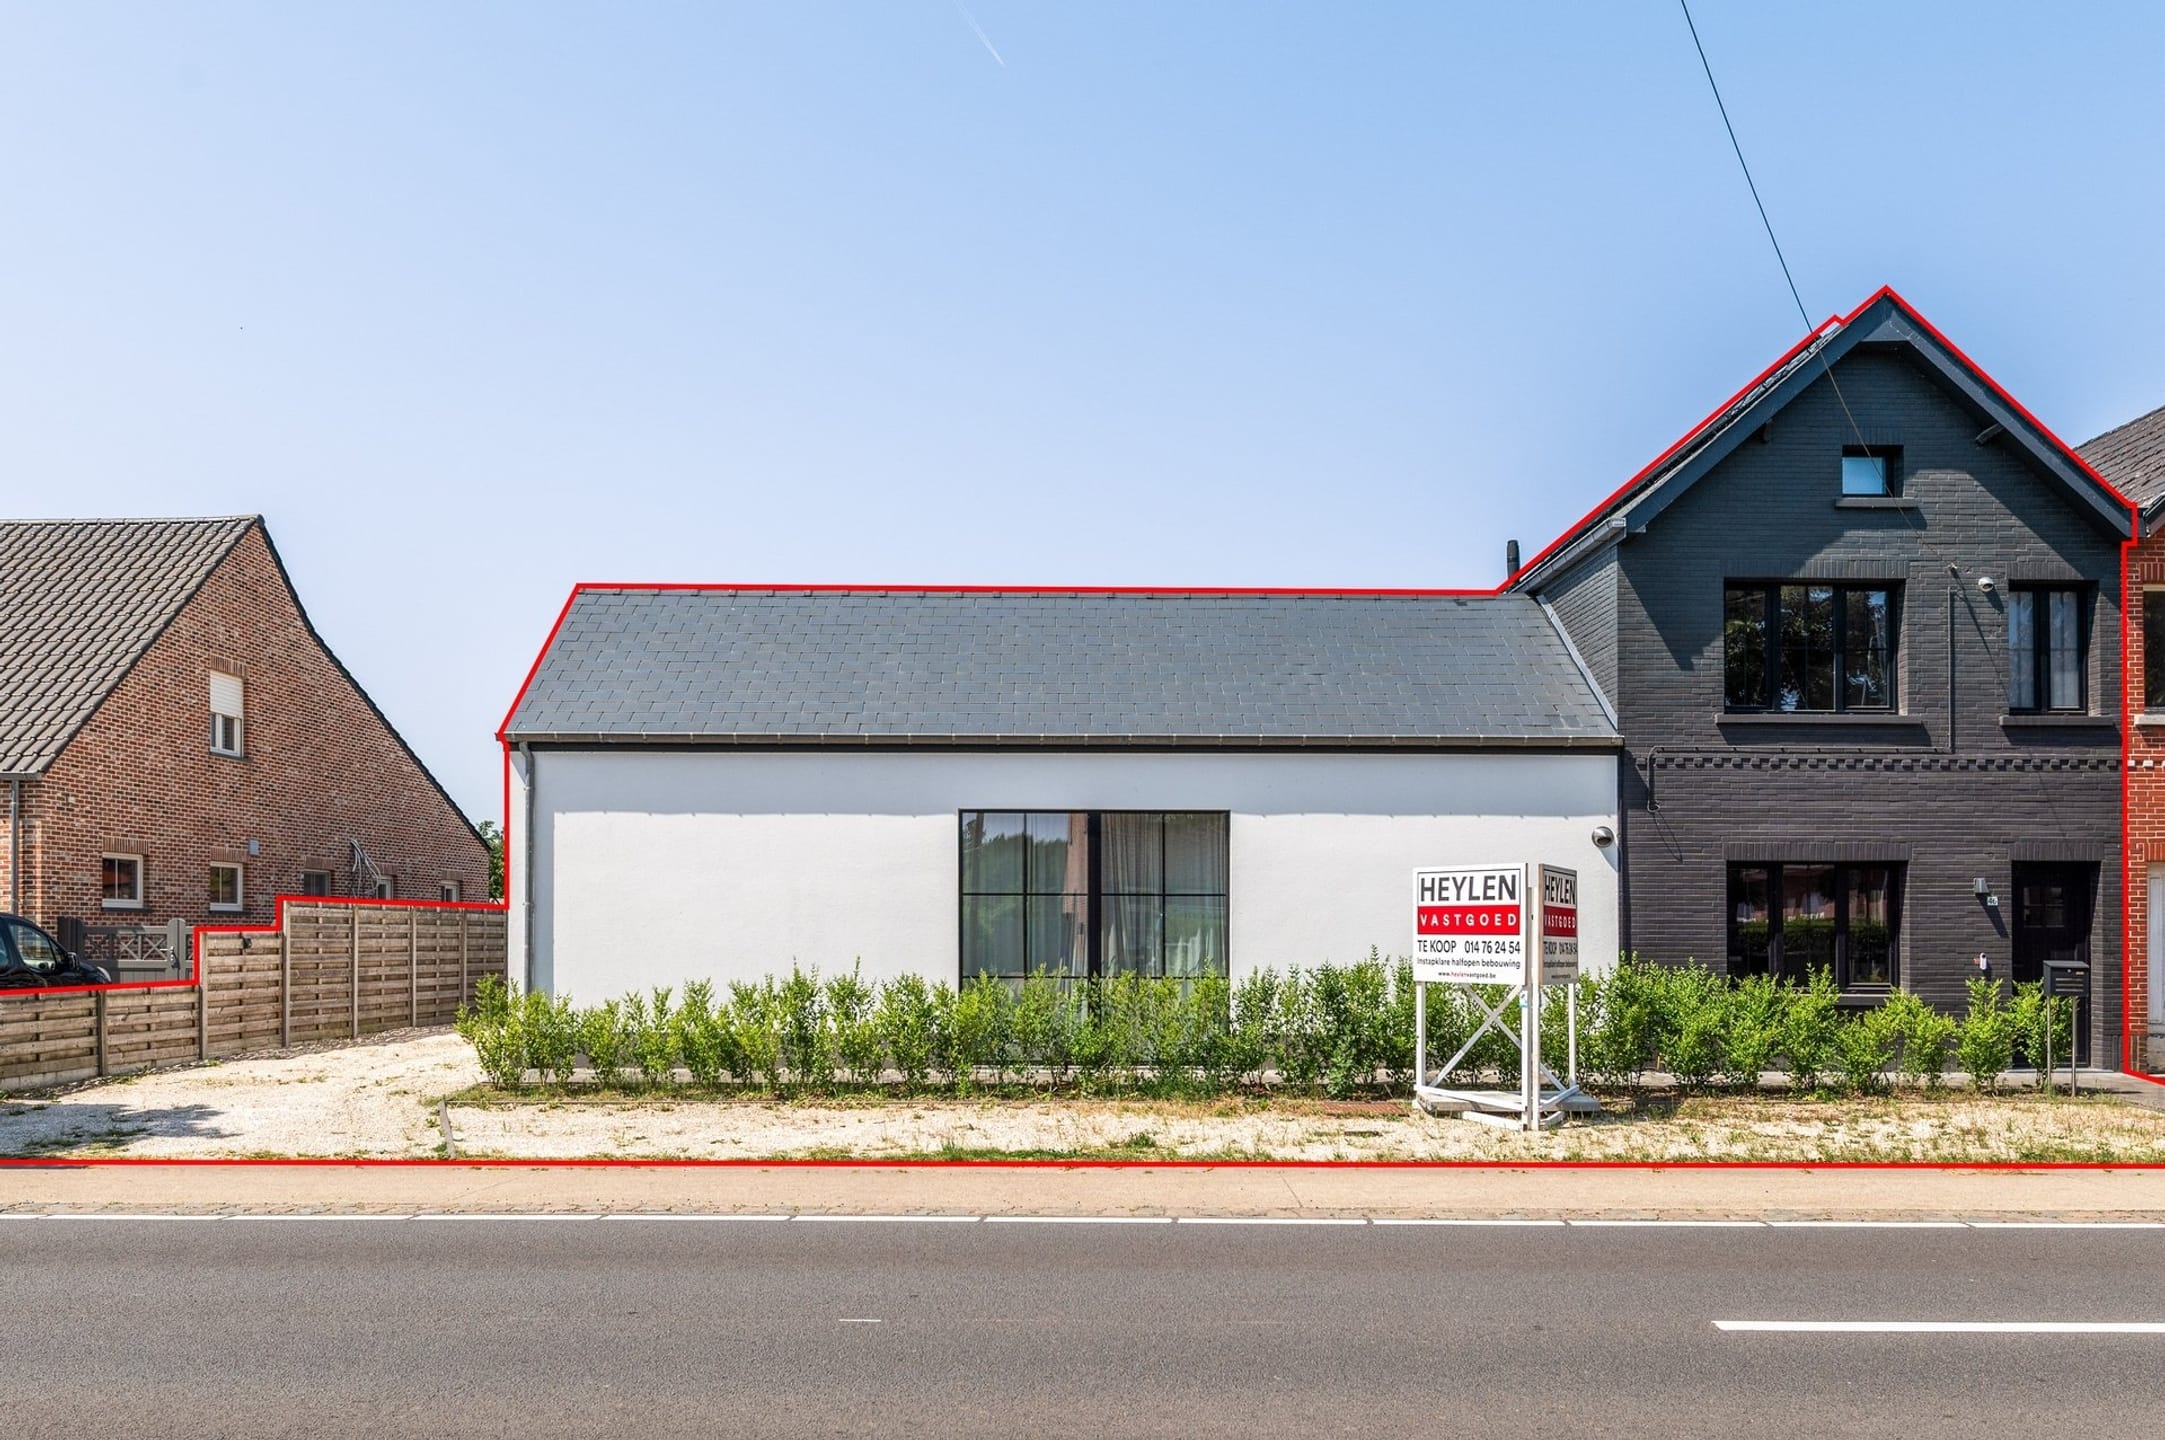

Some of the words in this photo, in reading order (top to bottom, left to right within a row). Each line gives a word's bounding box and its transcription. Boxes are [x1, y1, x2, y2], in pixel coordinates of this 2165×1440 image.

[1420, 874, 1516, 901] HEYLEN
[1544, 874, 1576, 905] HEYLEN
[1420, 913, 1517, 926] VASTGOED
[1544, 914, 1576, 929] VASTGOED
[1417, 940, 1428, 952] TE
[1430, 940, 1457, 953] KOOP
[1464, 940, 1480, 953] 014
[1481, 940, 1493, 954] 76
[1494, 940, 1506, 954] 24
[1508, 940, 1521, 954] 54
[1451, 957, 1480, 968] halfopen
[1481, 958, 1521, 970] bebouwing
